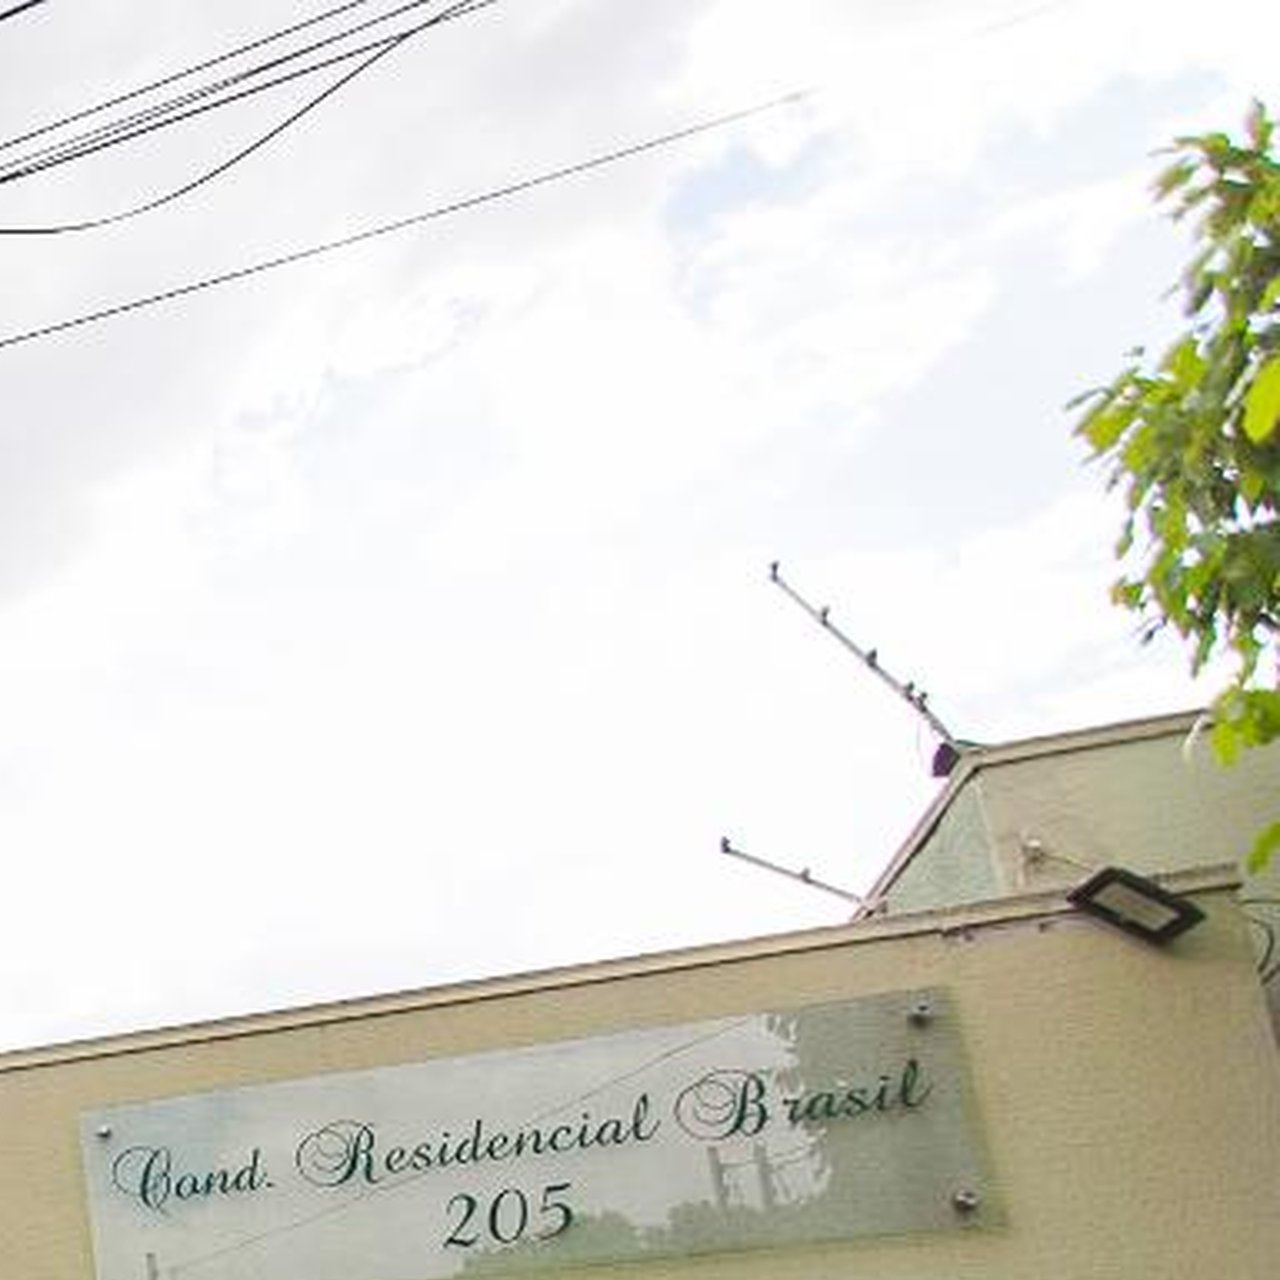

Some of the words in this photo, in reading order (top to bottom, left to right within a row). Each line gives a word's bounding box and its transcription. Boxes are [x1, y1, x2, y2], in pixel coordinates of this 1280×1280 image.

[112, 1146, 276, 1217] Cond.
[295, 1093, 661, 1188] Residencial
[674, 1059, 933, 1141] Brasil
[442, 1183, 573, 1249] 205
